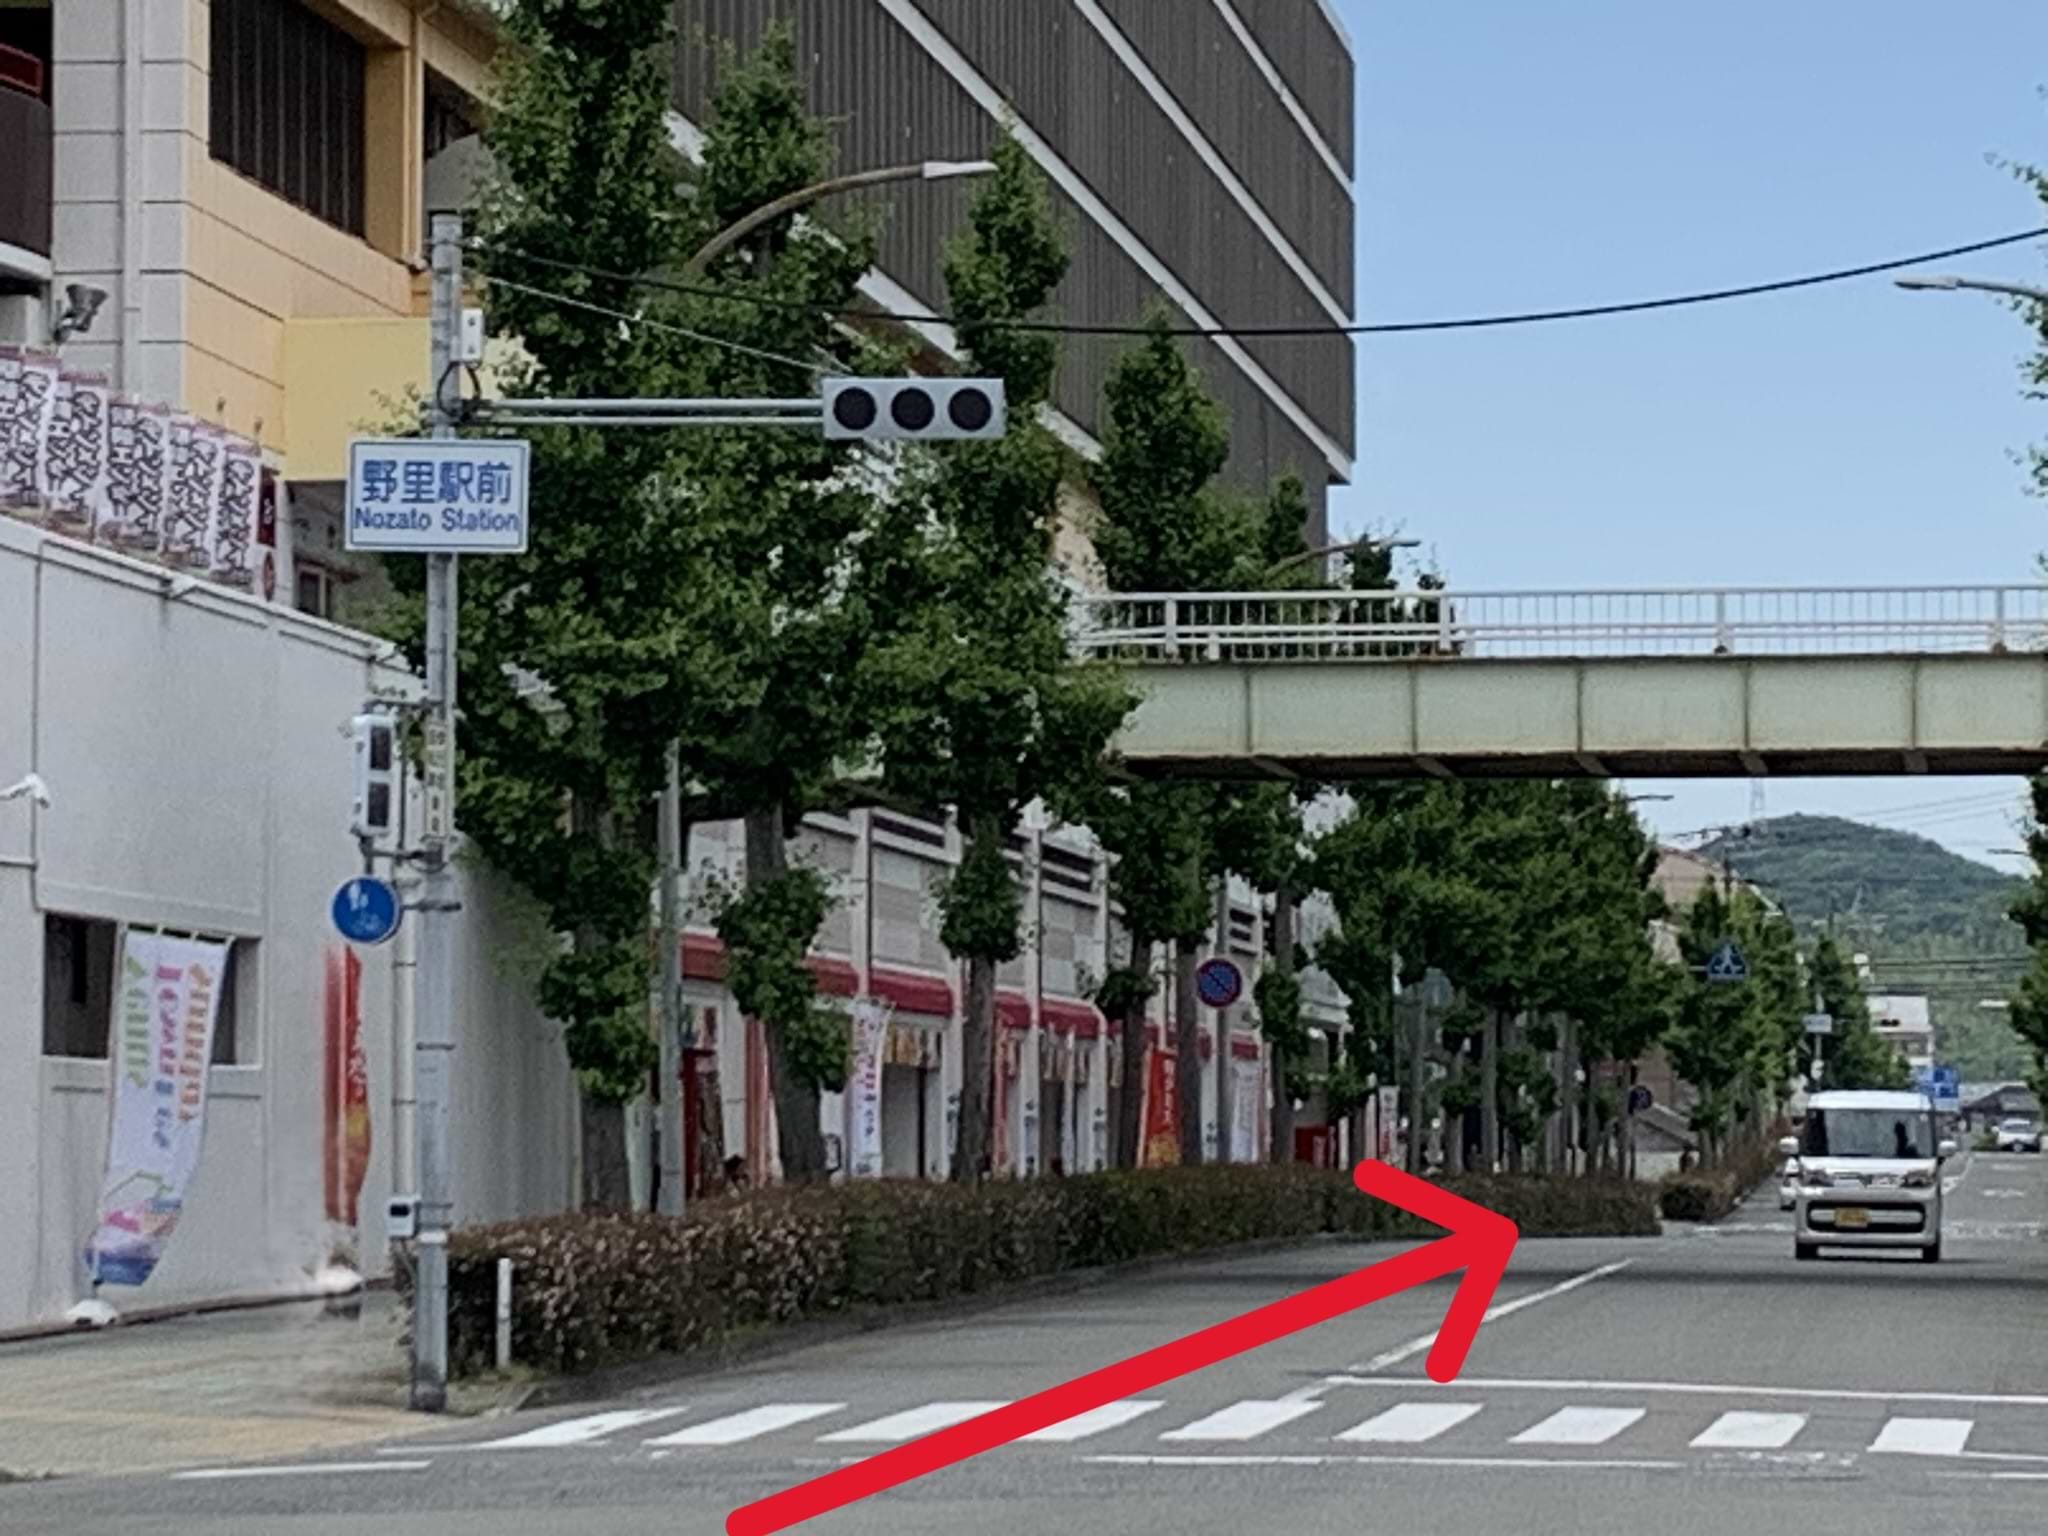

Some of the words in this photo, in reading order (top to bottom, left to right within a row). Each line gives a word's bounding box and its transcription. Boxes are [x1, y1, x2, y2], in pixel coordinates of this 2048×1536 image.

[362, 459, 513, 504] 野里駅前
[353, 507, 432, 531] Nozato
[441, 507, 520, 532] Station
